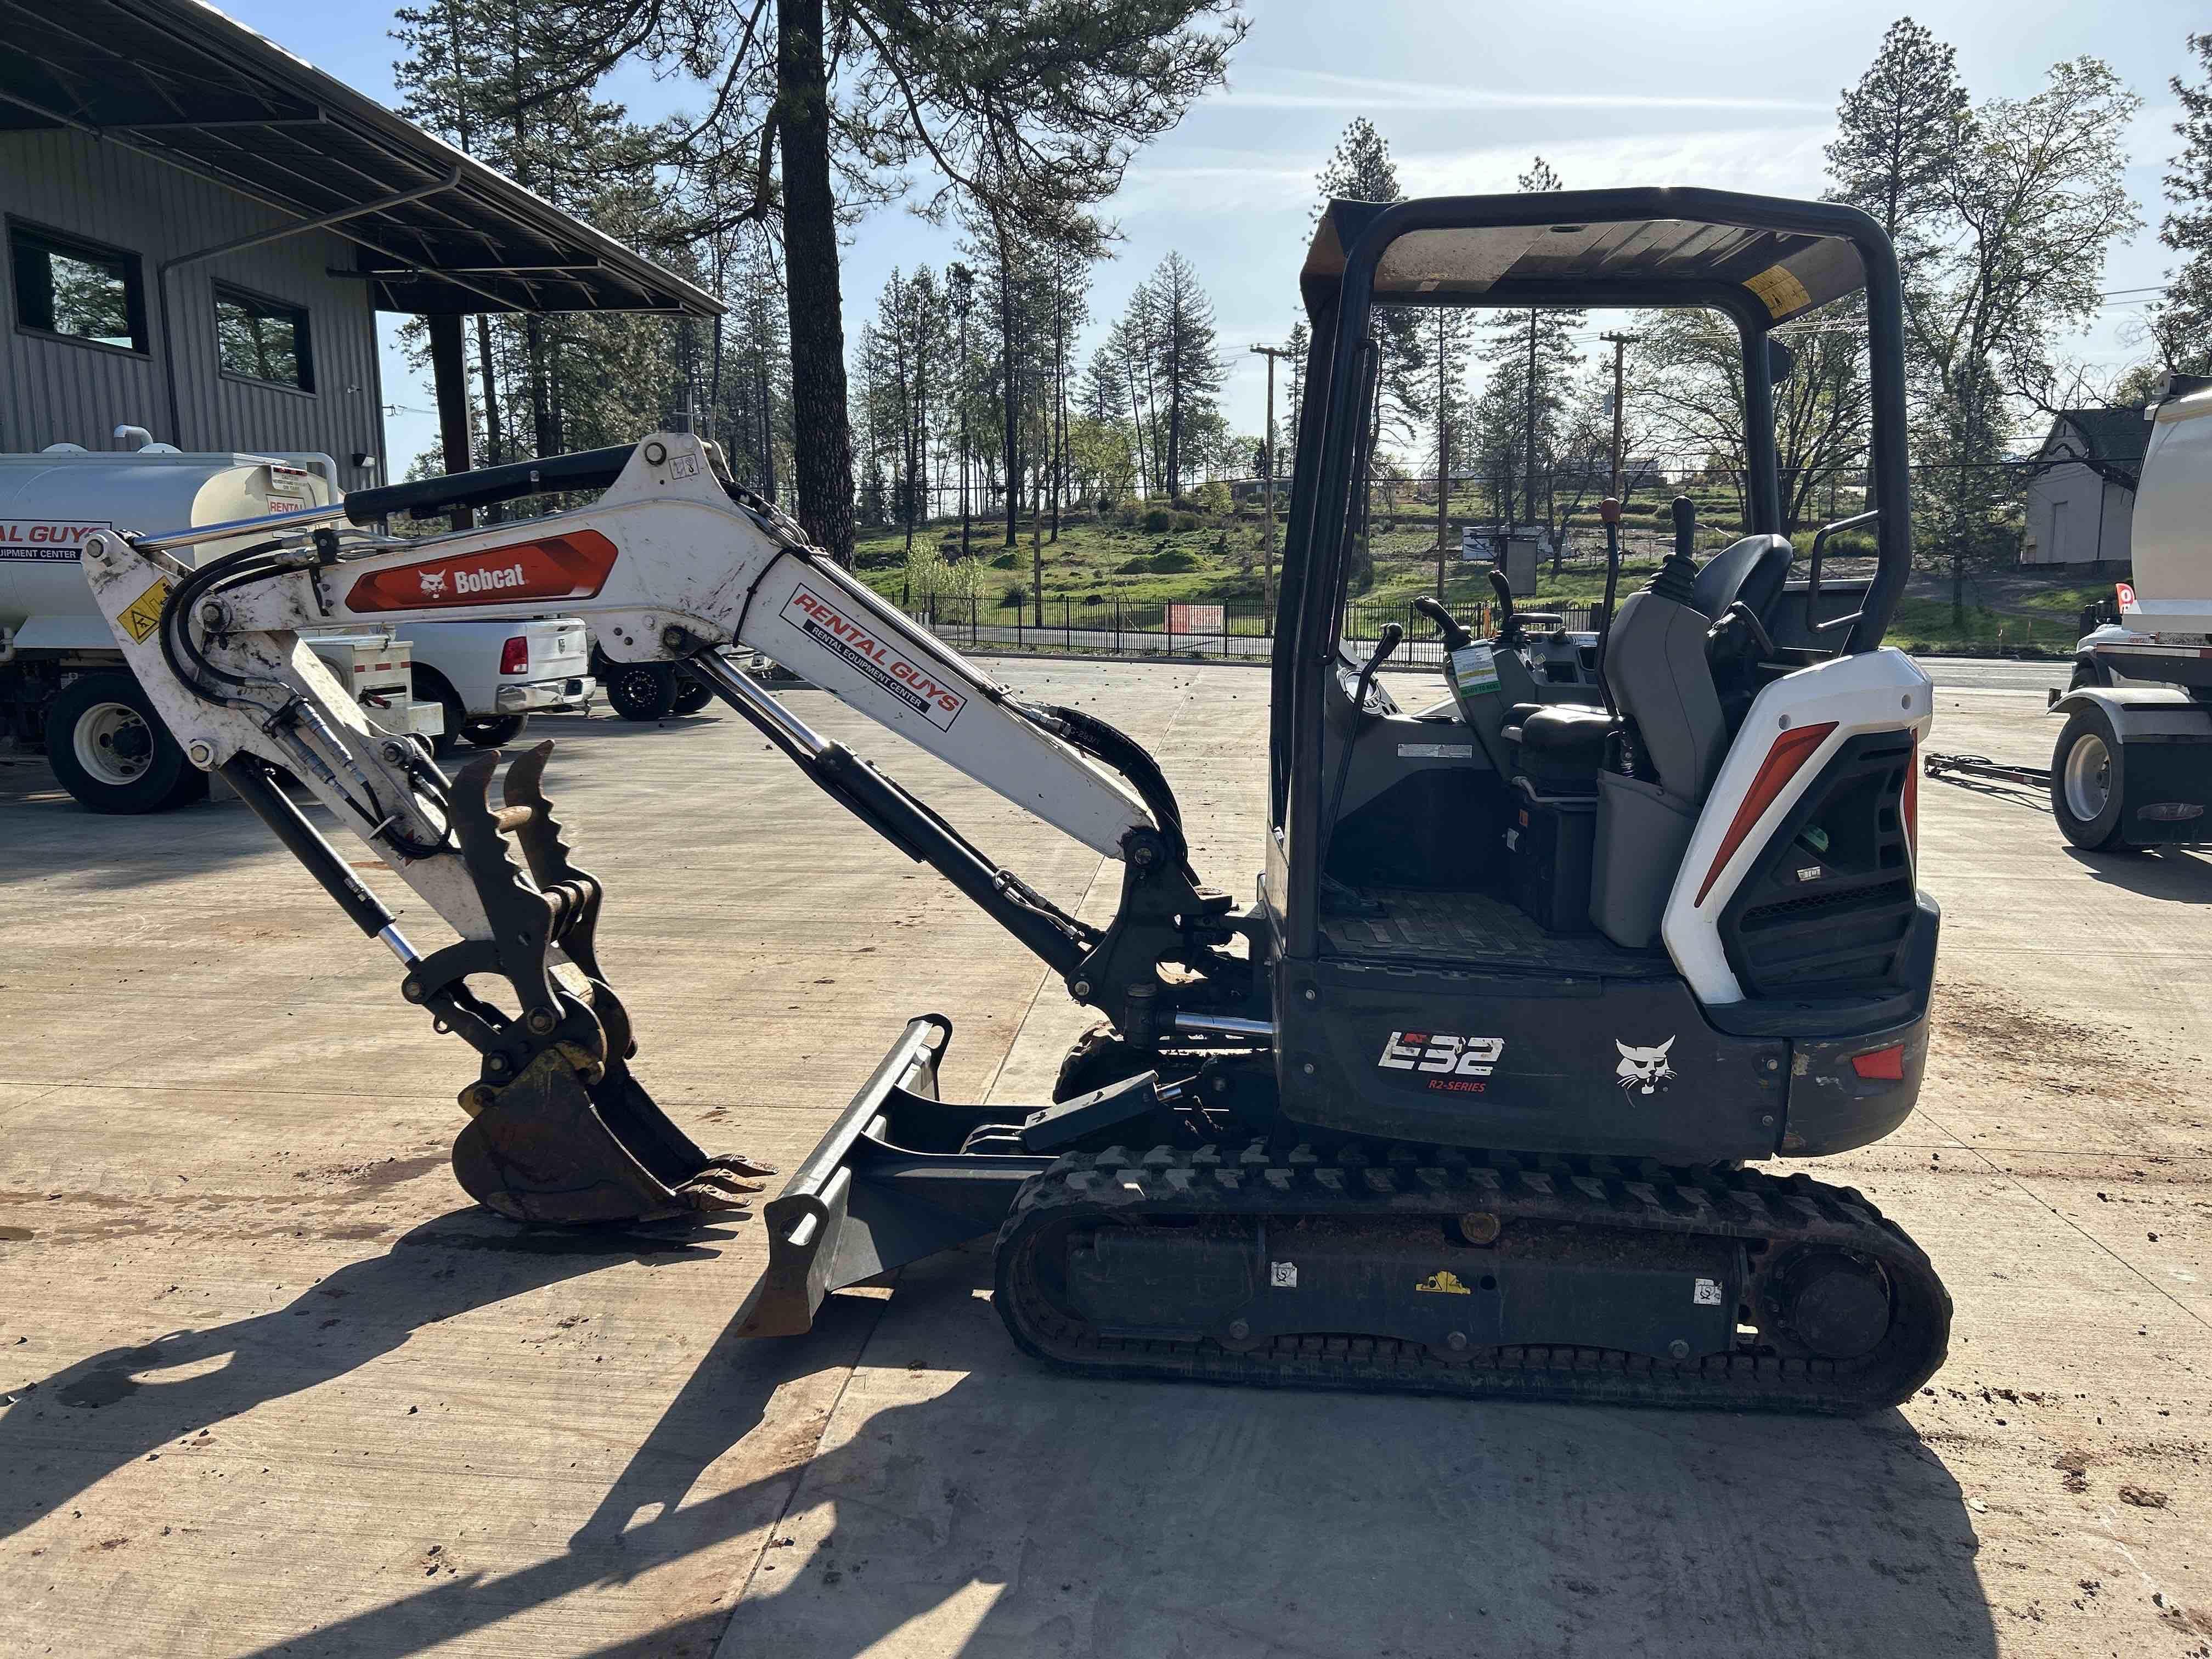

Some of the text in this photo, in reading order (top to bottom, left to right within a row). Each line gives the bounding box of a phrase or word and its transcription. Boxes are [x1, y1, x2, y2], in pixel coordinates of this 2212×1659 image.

[454, 563, 526, 594] Bobcat
[793, 593, 960, 712] RENTAL GUYS
[812, 627, 922, 707] RENTAL EQUIPMENT CENTER
[1378, 1031, 1505, 1076] E32
[1428, 1080, 1486, 1093] R2-SERIES
